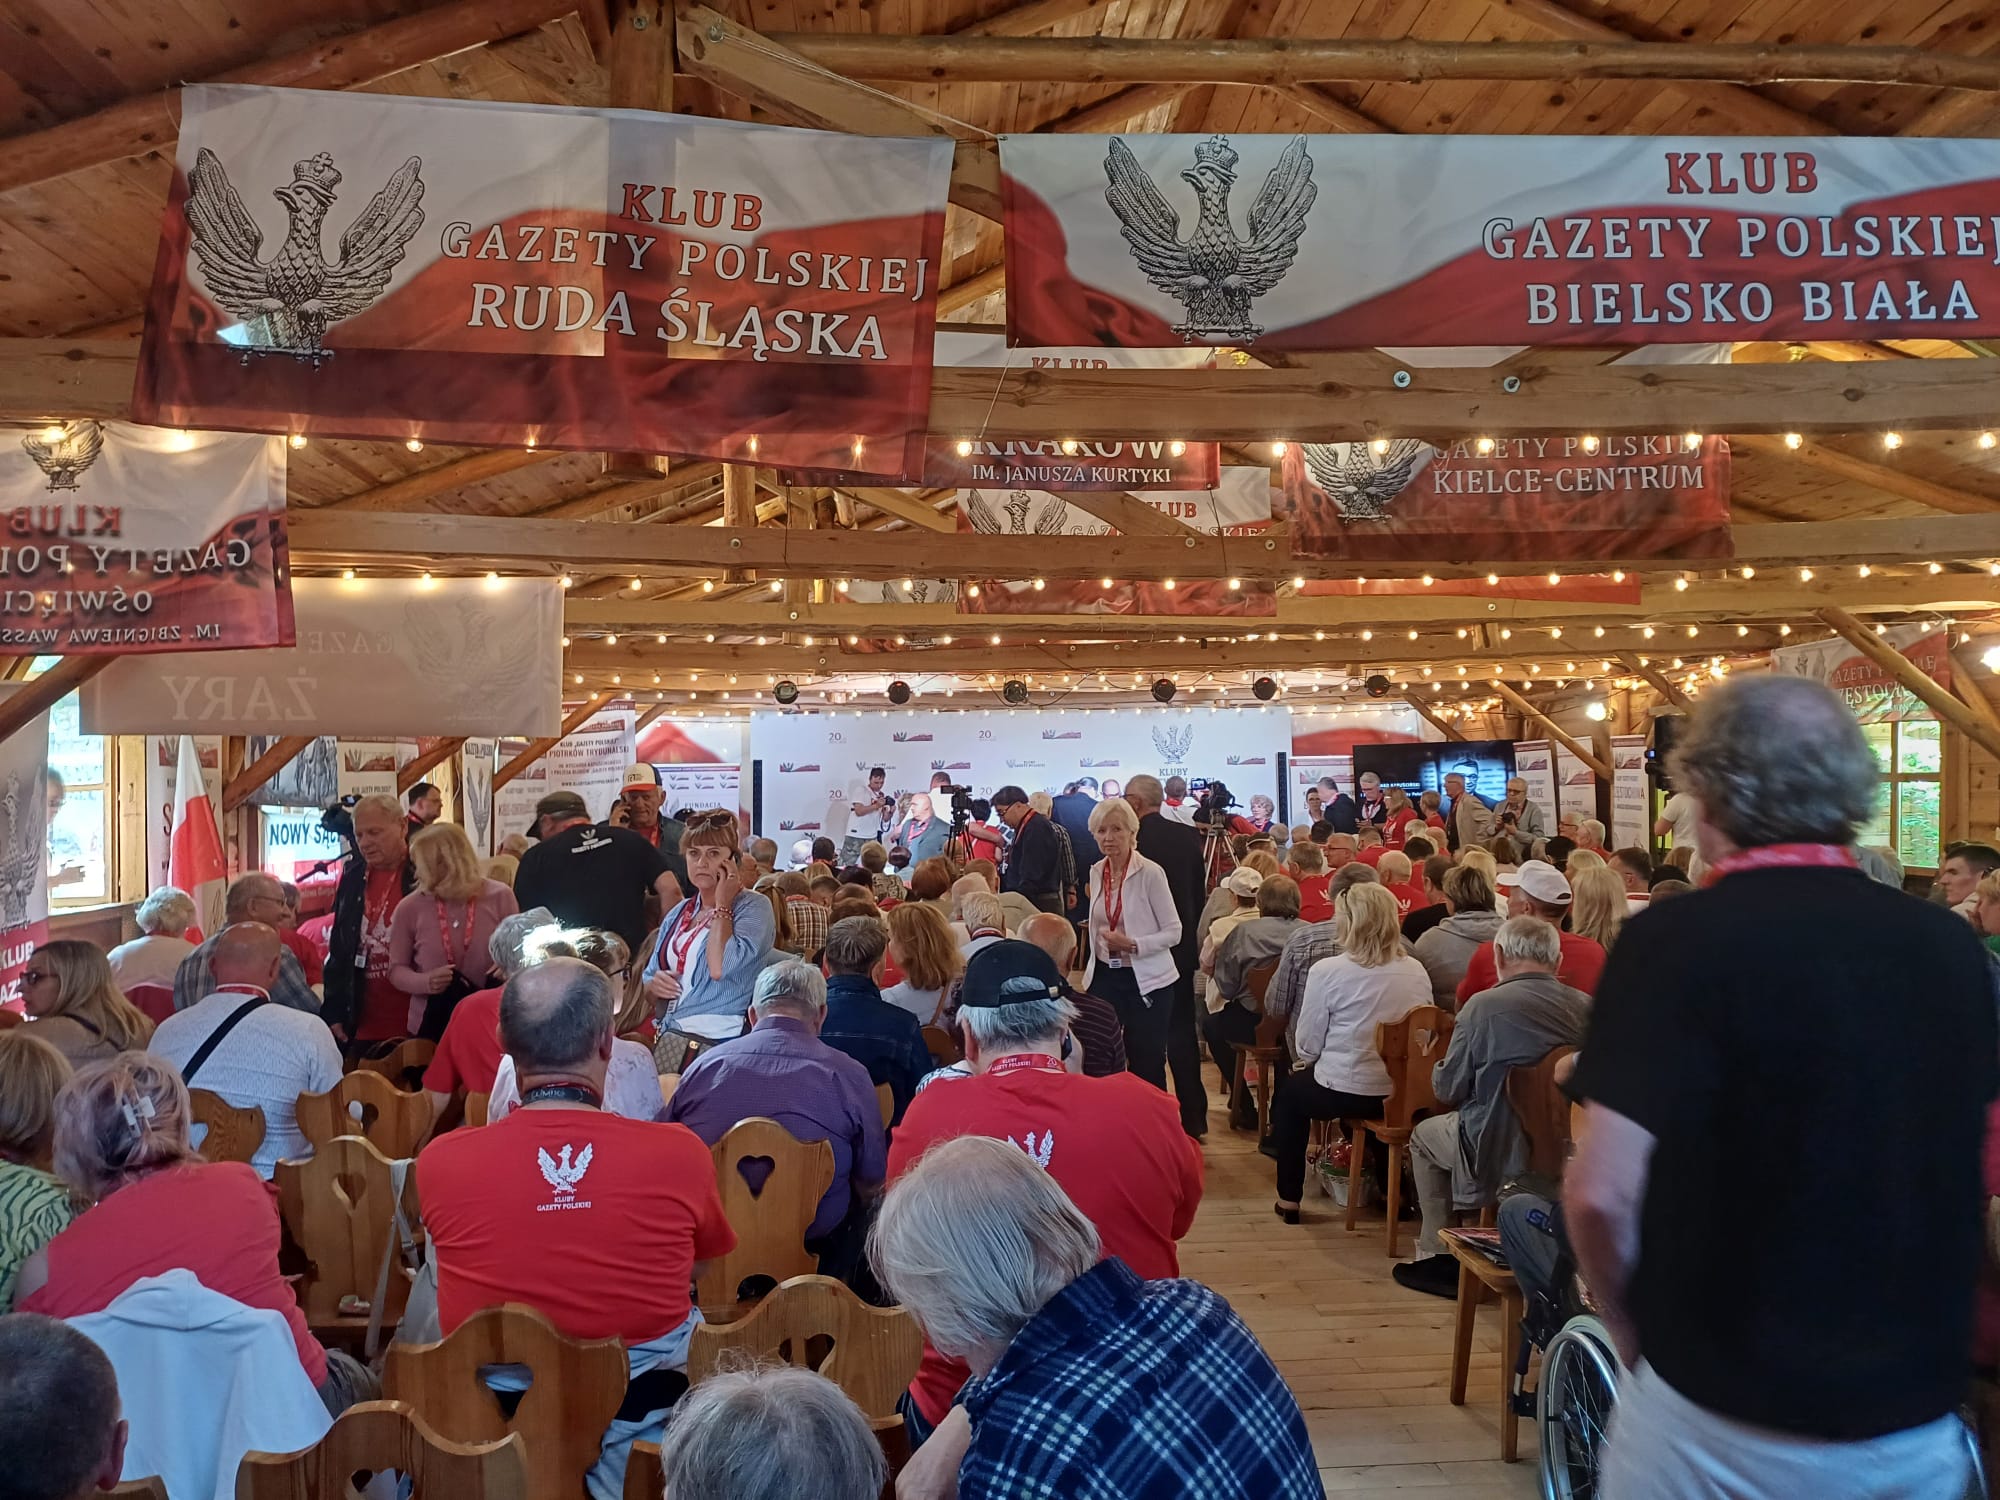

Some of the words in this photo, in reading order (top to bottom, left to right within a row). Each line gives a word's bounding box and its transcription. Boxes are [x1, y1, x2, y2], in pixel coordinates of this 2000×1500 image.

[1665, 152, 1819, 194] KLUB
[618, 183, 763, 231] KLUB
[1482, 217, 1712, 260] GAZETY
[441, 222, 656, 270] GAZETY
[678, 239, 929, 301] POLSKIEJ
[467, 282, 637, 336] RUDA
[656, 287, 889, 362] ŚLĄSKA
[1526, 282, 1774, 325] BIELSKO
[1800, 279, 1980, 322] BIAŁA
[972, 464, 1000, 481] IM.
[1004, 464, 1087, 484] JANUSZA
[1091, 466, 1172, 484] KURTYKI
[1433, 465, 1704, 495] KIELCE-CENTRUM
[1159, 768, 1188, 777] KLUBY
[269, 823, 310, 846] NOWY
